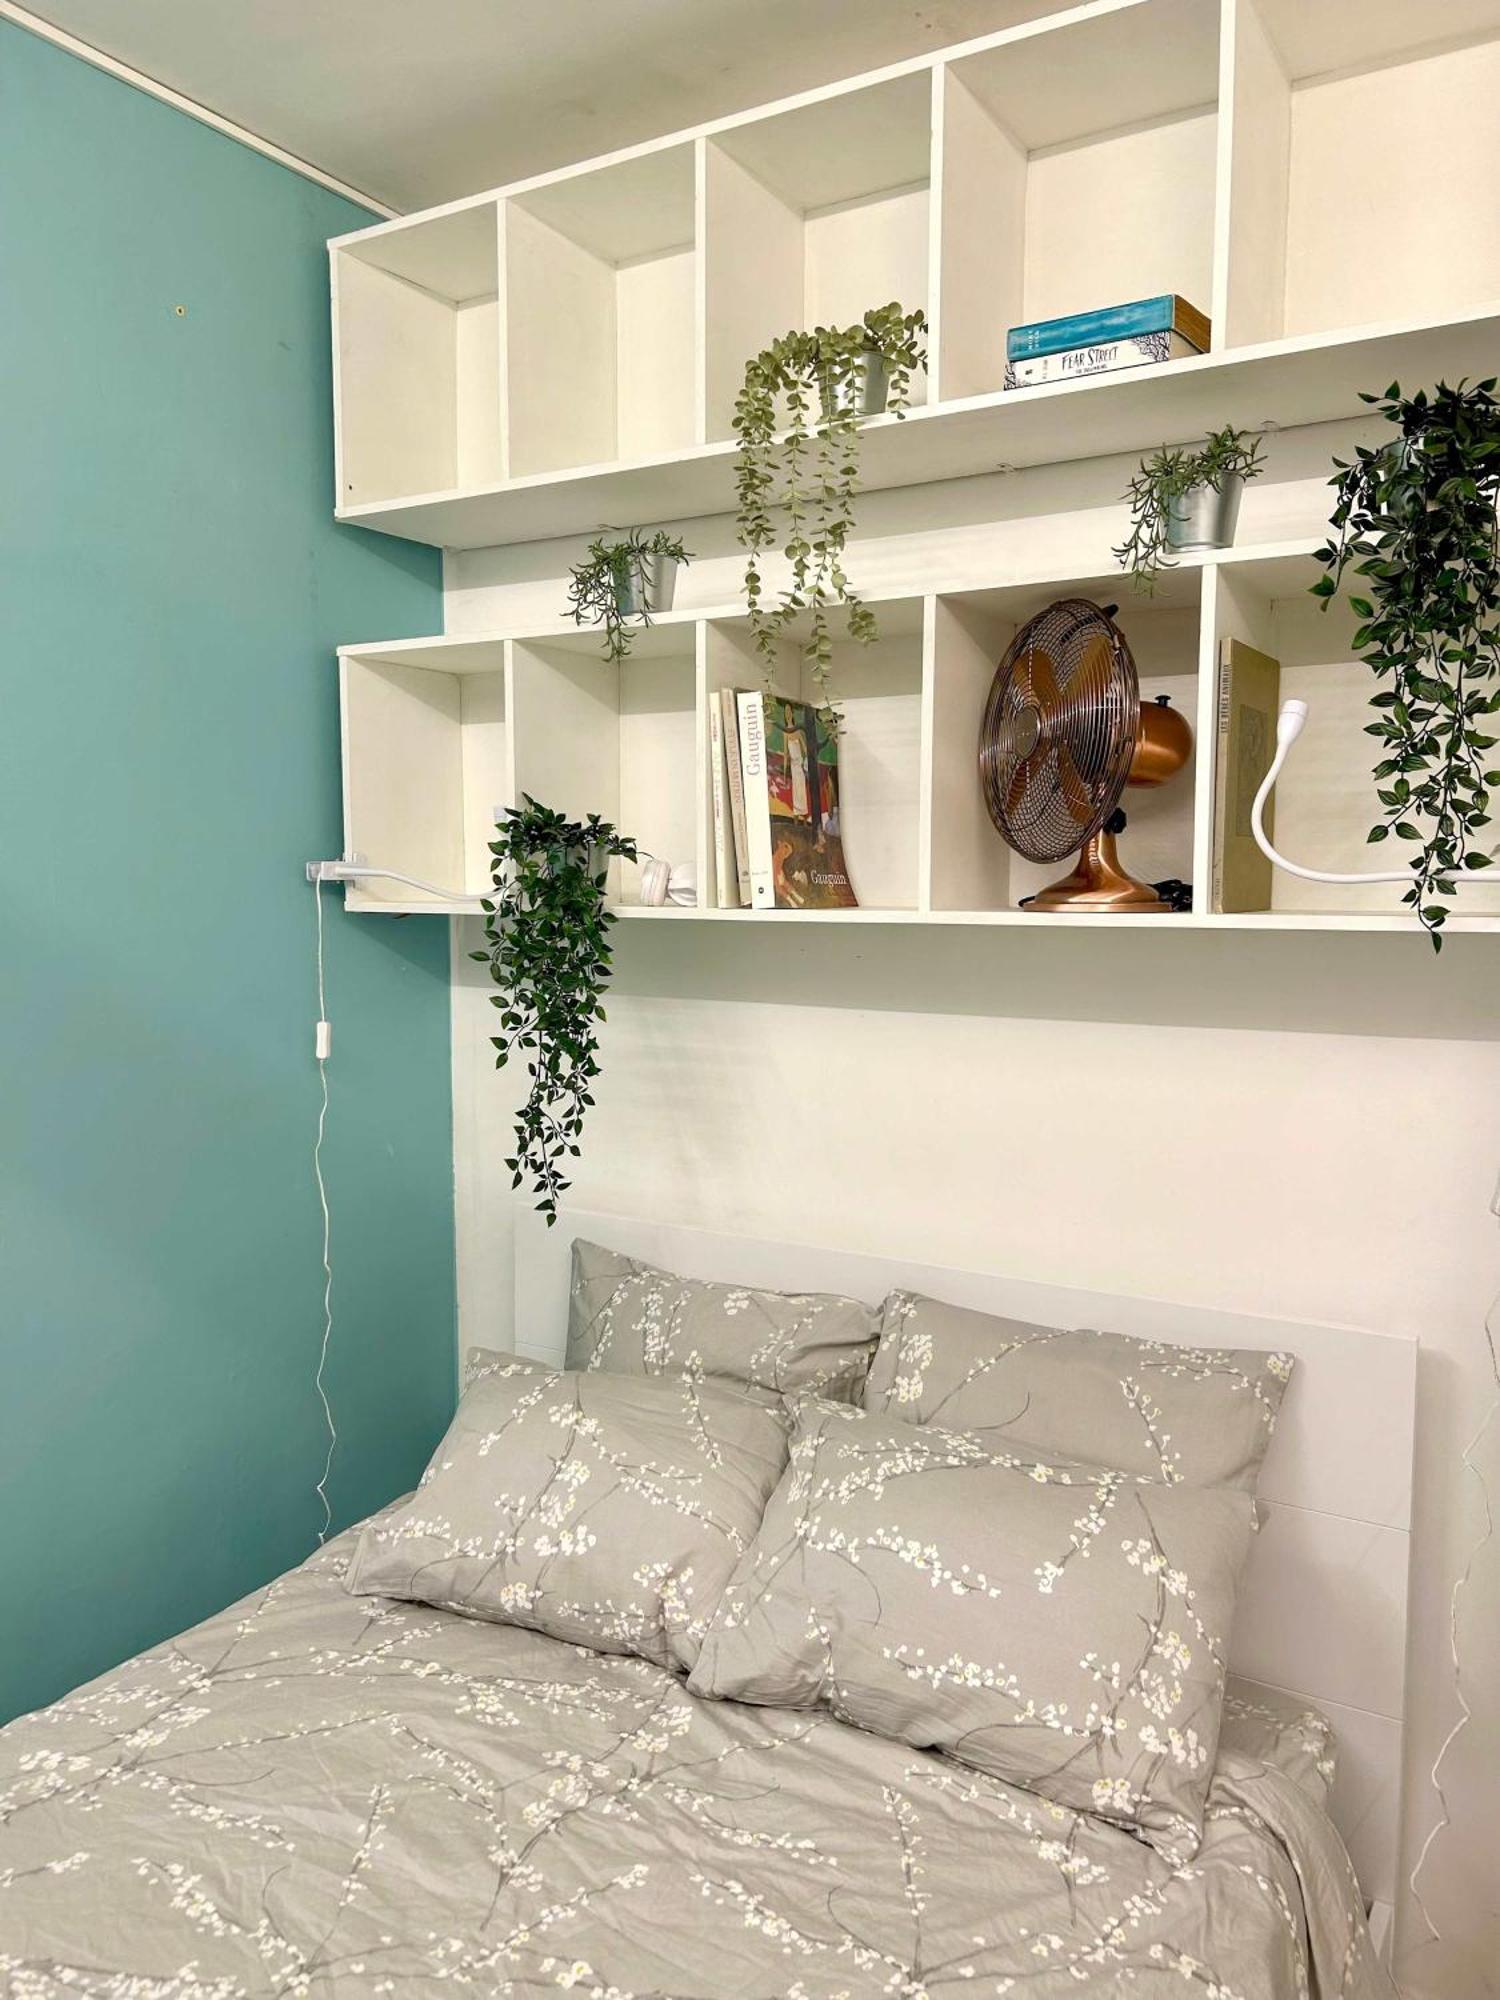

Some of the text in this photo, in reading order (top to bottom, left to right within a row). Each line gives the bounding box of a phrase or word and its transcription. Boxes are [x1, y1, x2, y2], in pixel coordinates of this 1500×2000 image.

[1062, 353, 1084, 371] FEAR
[1087, 346, 1119, 366] STREET
[745, 703, 762, 776] Gauguin
[811, 869, 848, 887] Gauguin
